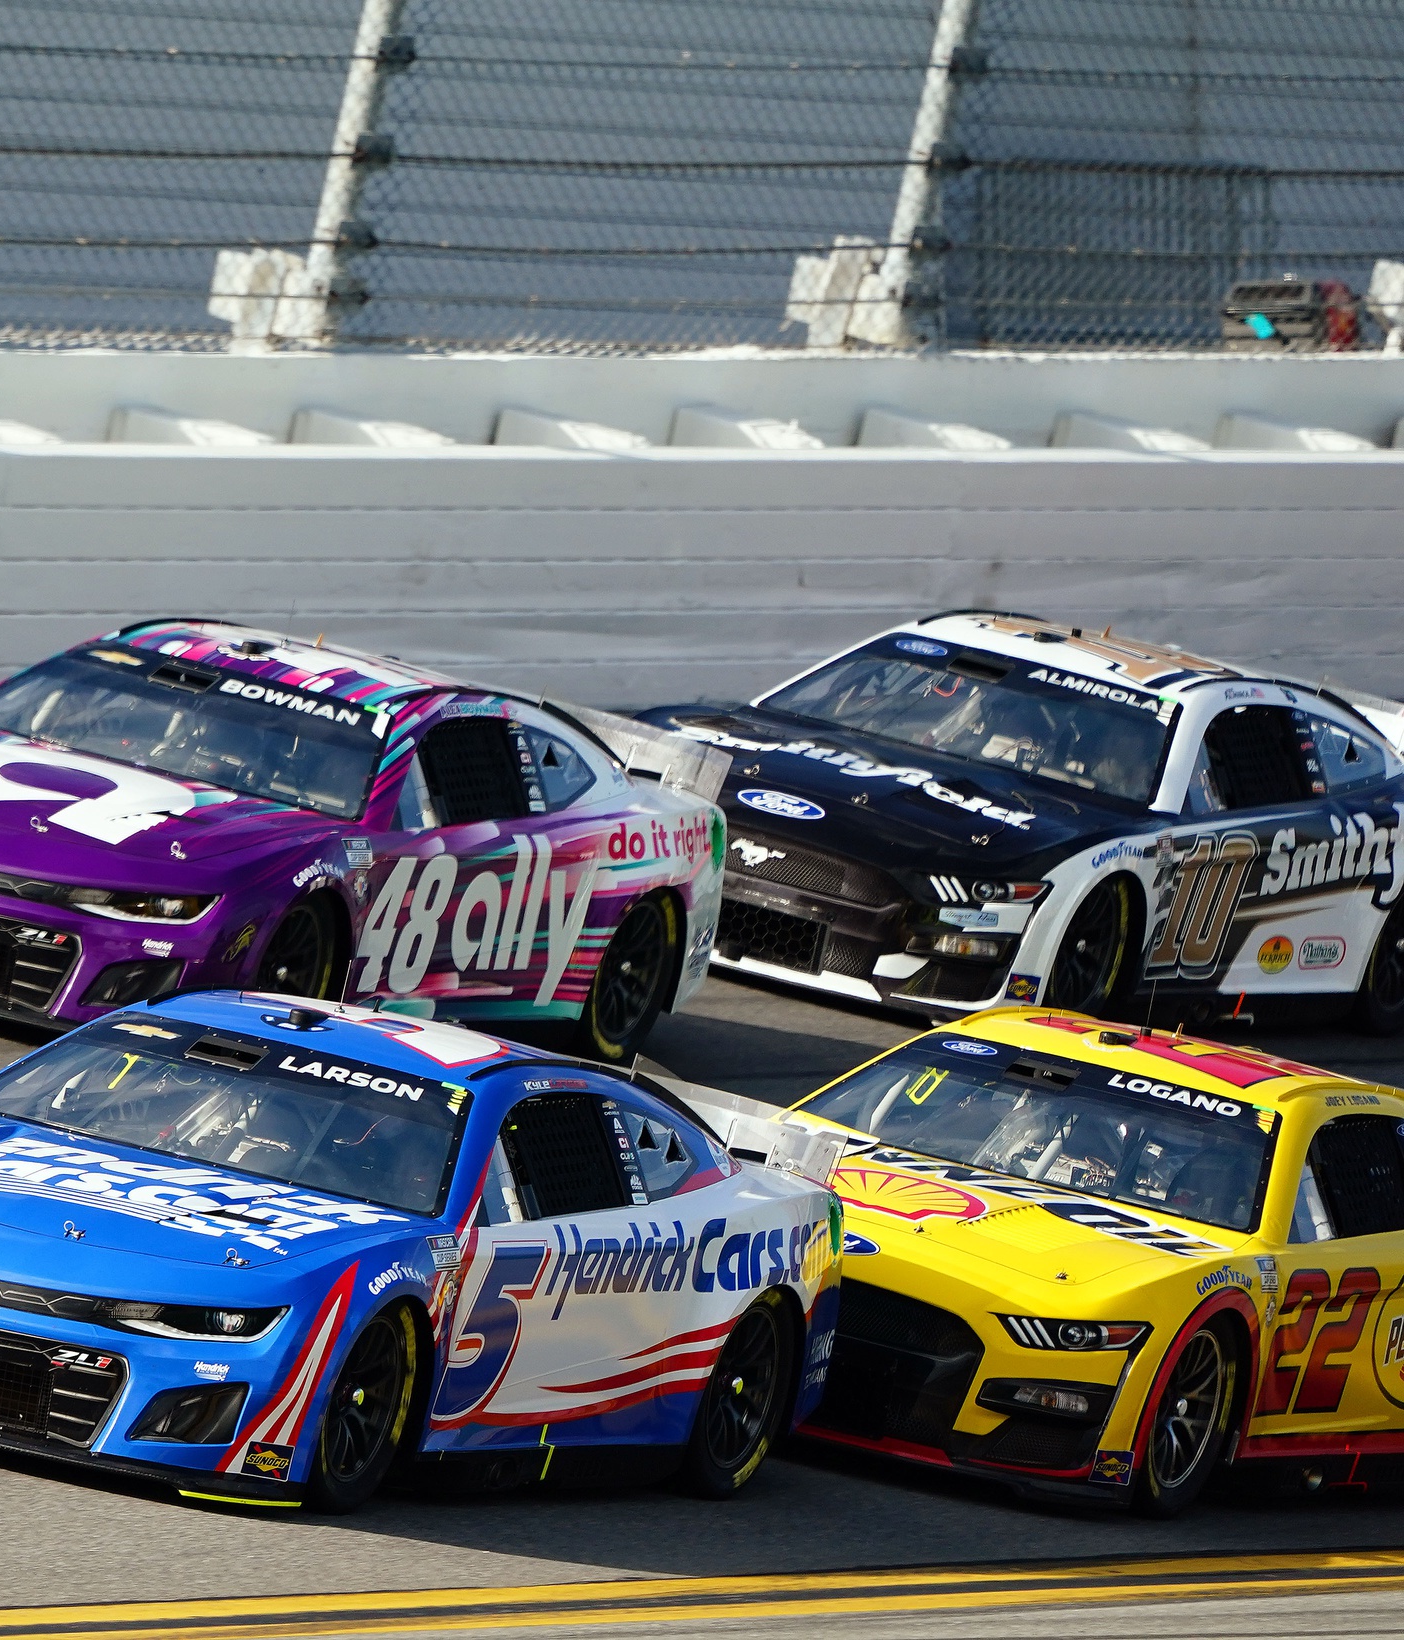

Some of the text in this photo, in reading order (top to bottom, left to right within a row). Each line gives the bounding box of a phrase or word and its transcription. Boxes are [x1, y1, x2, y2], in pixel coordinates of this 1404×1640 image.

[219, 678, 361, 726] BOWMAN
[1027, 668, 1158, 712] ALMIROLA
[747, 791, 814, 817] Ford
[608, 822, 646, 860] do
[651, 819, 671, 858] it
[1091, 841, 1144, 869] GOODYEAR
[355, 834, 595, 1007] 48 ally
[1145, 831, 1259, 979] 10
[16, 926, 67, 946] ZL1
[948, 1041, 991, 1054] Ford
[278, 1055, 425, 1102] LARSON
[522, 1079, 550, 1092] KYLE
[1107, 1073, 1242, 1117] LOGANO
[367, 1261, 428, 1295] GOODYEAR
[1196, 1265, 1252, 1296] GOODYEAR
[430, 1240, 552, 1430] 5
[1252, 1267, 1381, 1418] 22
[51, 1349, 112, 1368] ZL1
[193, 1361, 230, 1374] Hendrick
[248, 1455, 287, 1467] SUNOCO
